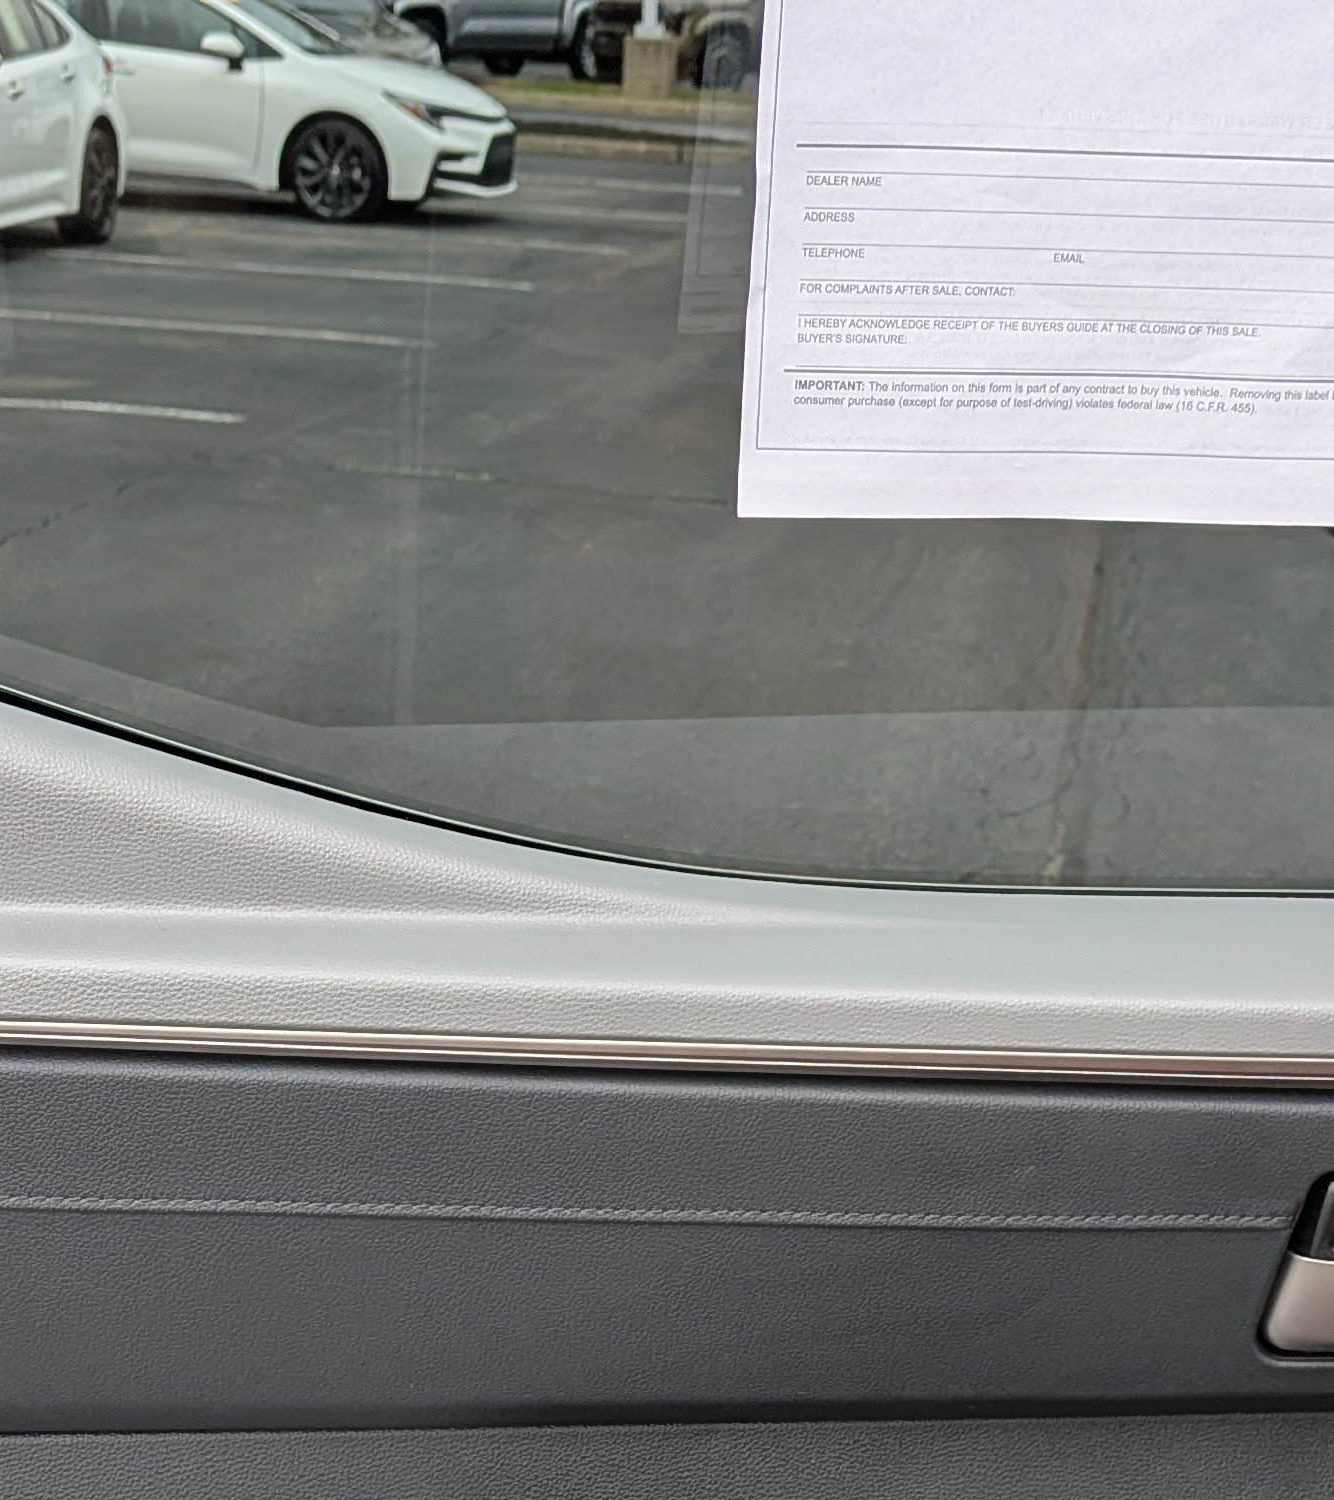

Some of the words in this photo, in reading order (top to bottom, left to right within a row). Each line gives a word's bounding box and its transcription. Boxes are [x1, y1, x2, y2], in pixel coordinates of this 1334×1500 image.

[806, 175, 849, 186] DEALER
[851, 176, 883, 187] NAME
[803, 211, 855, 222] ADDRESS
[802, 247, 865, 259] TELEPHONE
[1053, 253, 1085, 264] EMAIL
[800, 283, 822, 294] FOR
[825, 284, 893, 295] COMPLAINTS
[895, 285, 929, 296] AFTER
[932, 286, 962, 297] SALE,
[964, 286, 1016, 298] CONTACT:
[804, 318, 846, 328] HEREBY
[849, 319, 931, 329] ACKNOWLEDGE
[933, 320, 978, 330] RECEIPT
[981, 321, 995, 330] OF
[999, 321, 1018, 331] THE
[1021, 322, 1064, 332] BUYERS
[1066, 322, 1099, 333] GUIDE
[1100, 323, 1114, 333] AT
[1117, 323, 1137, 334] THE
[1139, 323, 1186, 335] CLOSING
[1188, 325, 1204, 336] OF
[1206, 326, 1229, 336] THIS
[1232, 327, 1261, 338] SALE.
[797, 333, 842, 344] BUYER'S
[845, 333, 907, 345] SIGNATURE:
[794, 379, 865, 391] IMPORTANT:
[869, 381, 889, 392] The
[892, 382, 949, 392] information
[952, 384, 965, 393] on
[968, 383, 986, 393] this
[989, 383, 1012, 394] form
[1014, 383, 1024, 394] is
[1026, 383, 1047, 395] part
[1049, 383, 1061, 394] of
[1062, 385, 1081, 396] any
[1083, 384, 1125, 395] contract
[1127, 385, 1138, 396] to
[1140, 385, 1160, 398] buy
[1162, 386, 1181, 397] this
[1183, 387, 1223, 398] vehicle.
[1229, 387, 1281, 402] Removing
[1284, 389, 1302, 401] this
[1305, 389, 1329, 401] label
[793, 395, 845, 405] consumer
[847, 396, 896, 407] purchase
[898, 396, 937, 409] (except
[939, 397, 954, 408] for
[956, 398, 998, 410] purpose
[1000, 398, 1012, 408] of
[1013, 398, 1073, 410] test-driving)
[1075, 399, 1115, 409] violates
[1117, 399, 1153, 410] federal
[1155, 400, 1173, 410] law
[1176, 400, 1194, 413] (16
